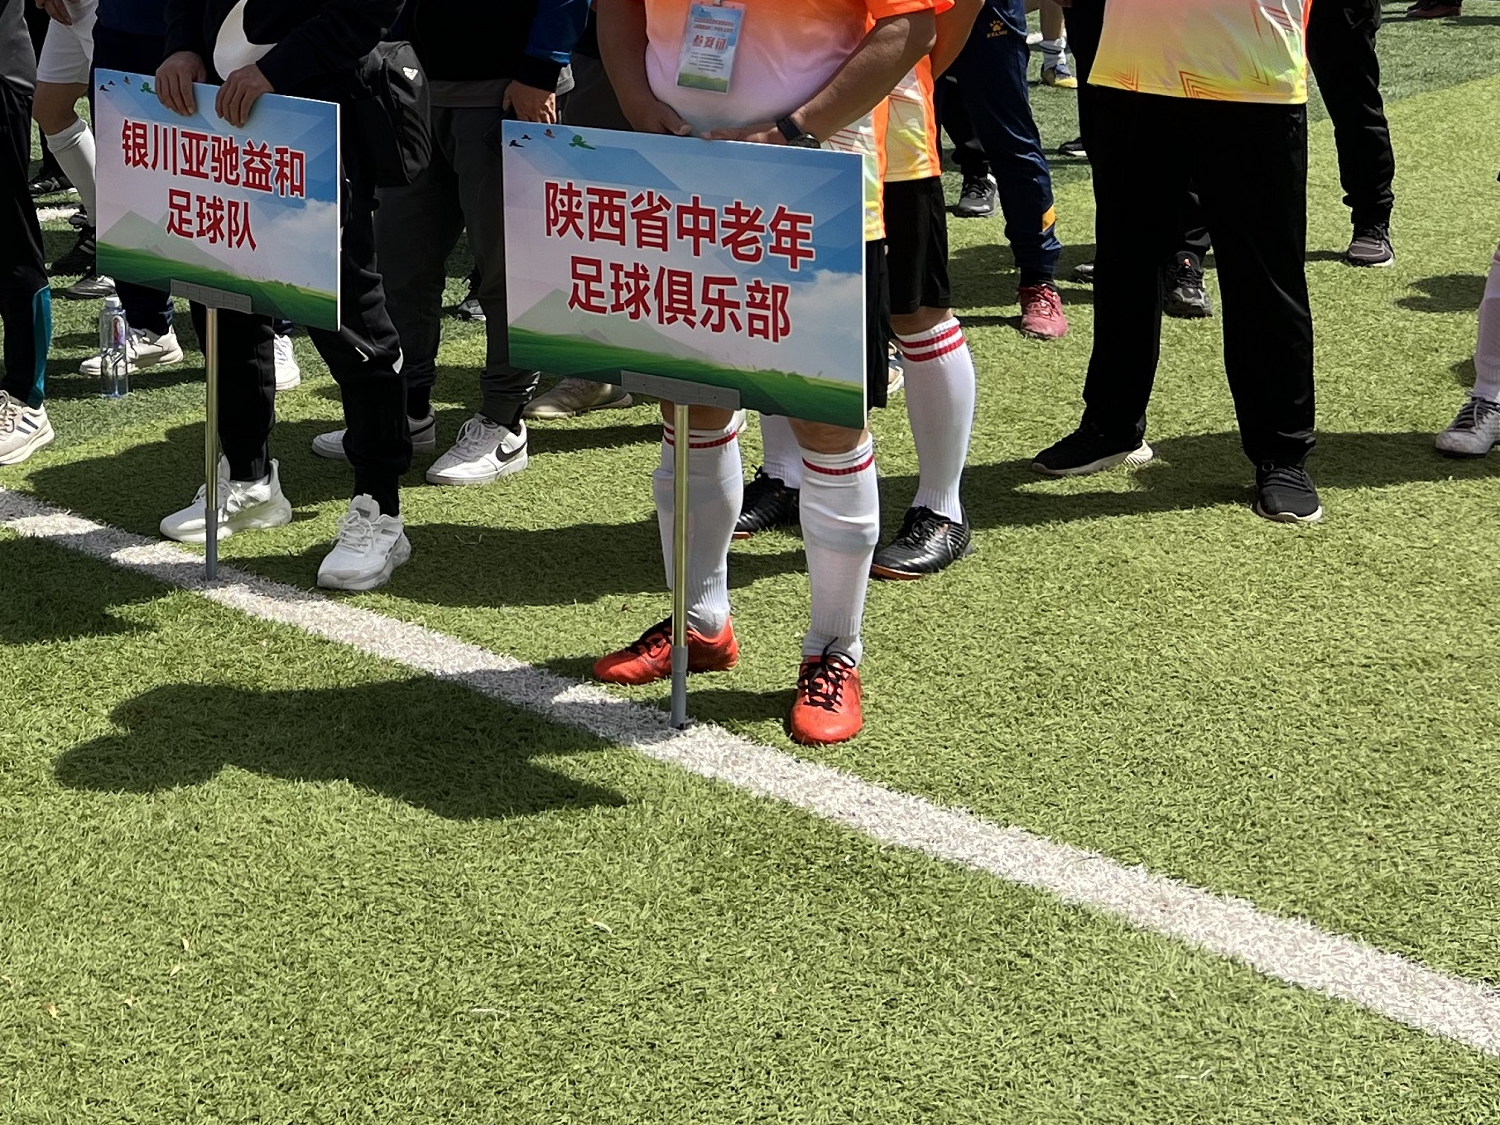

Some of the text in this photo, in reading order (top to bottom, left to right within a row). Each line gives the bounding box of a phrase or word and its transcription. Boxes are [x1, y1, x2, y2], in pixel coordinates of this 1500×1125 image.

[121, 118, 306, 200] 银川亚驰益和
[165, 187, 258, 253] 足球队
[544, 181, 816, 272] 陕西省中老年
[567, 255, 793, 344] 足球俱乐部
